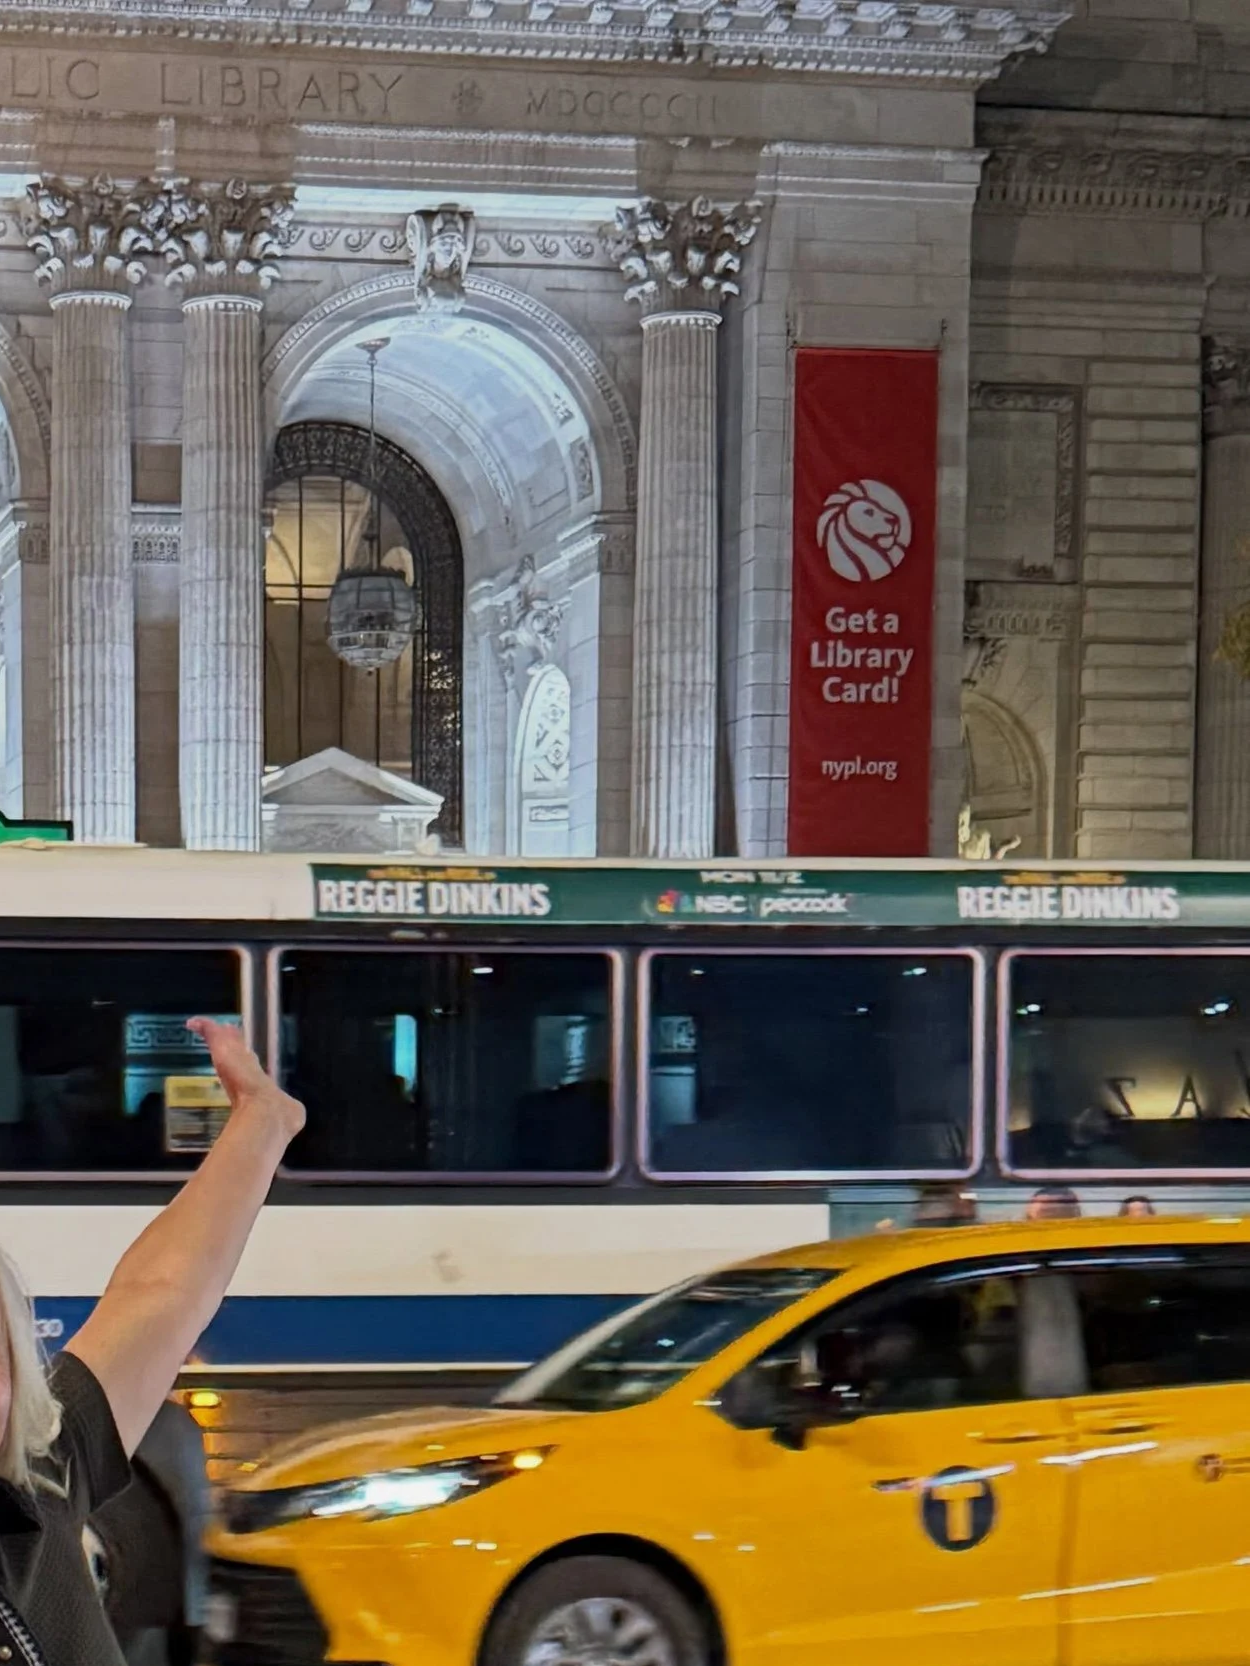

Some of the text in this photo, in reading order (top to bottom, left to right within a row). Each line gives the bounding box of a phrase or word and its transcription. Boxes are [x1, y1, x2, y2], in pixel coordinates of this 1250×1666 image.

[160, 63, 403, 115] LIBRARY
[825, 606, 899, 634] Get a
[810, 640, 914, 677] Library
[822, 676, 899, 704] Card!
[821, 756, 898, 781] nypl.org
[318, 880, 552, 916] REGGIE DINKINS
[957, 886, 1180, 919] REGGIE DINKINS
